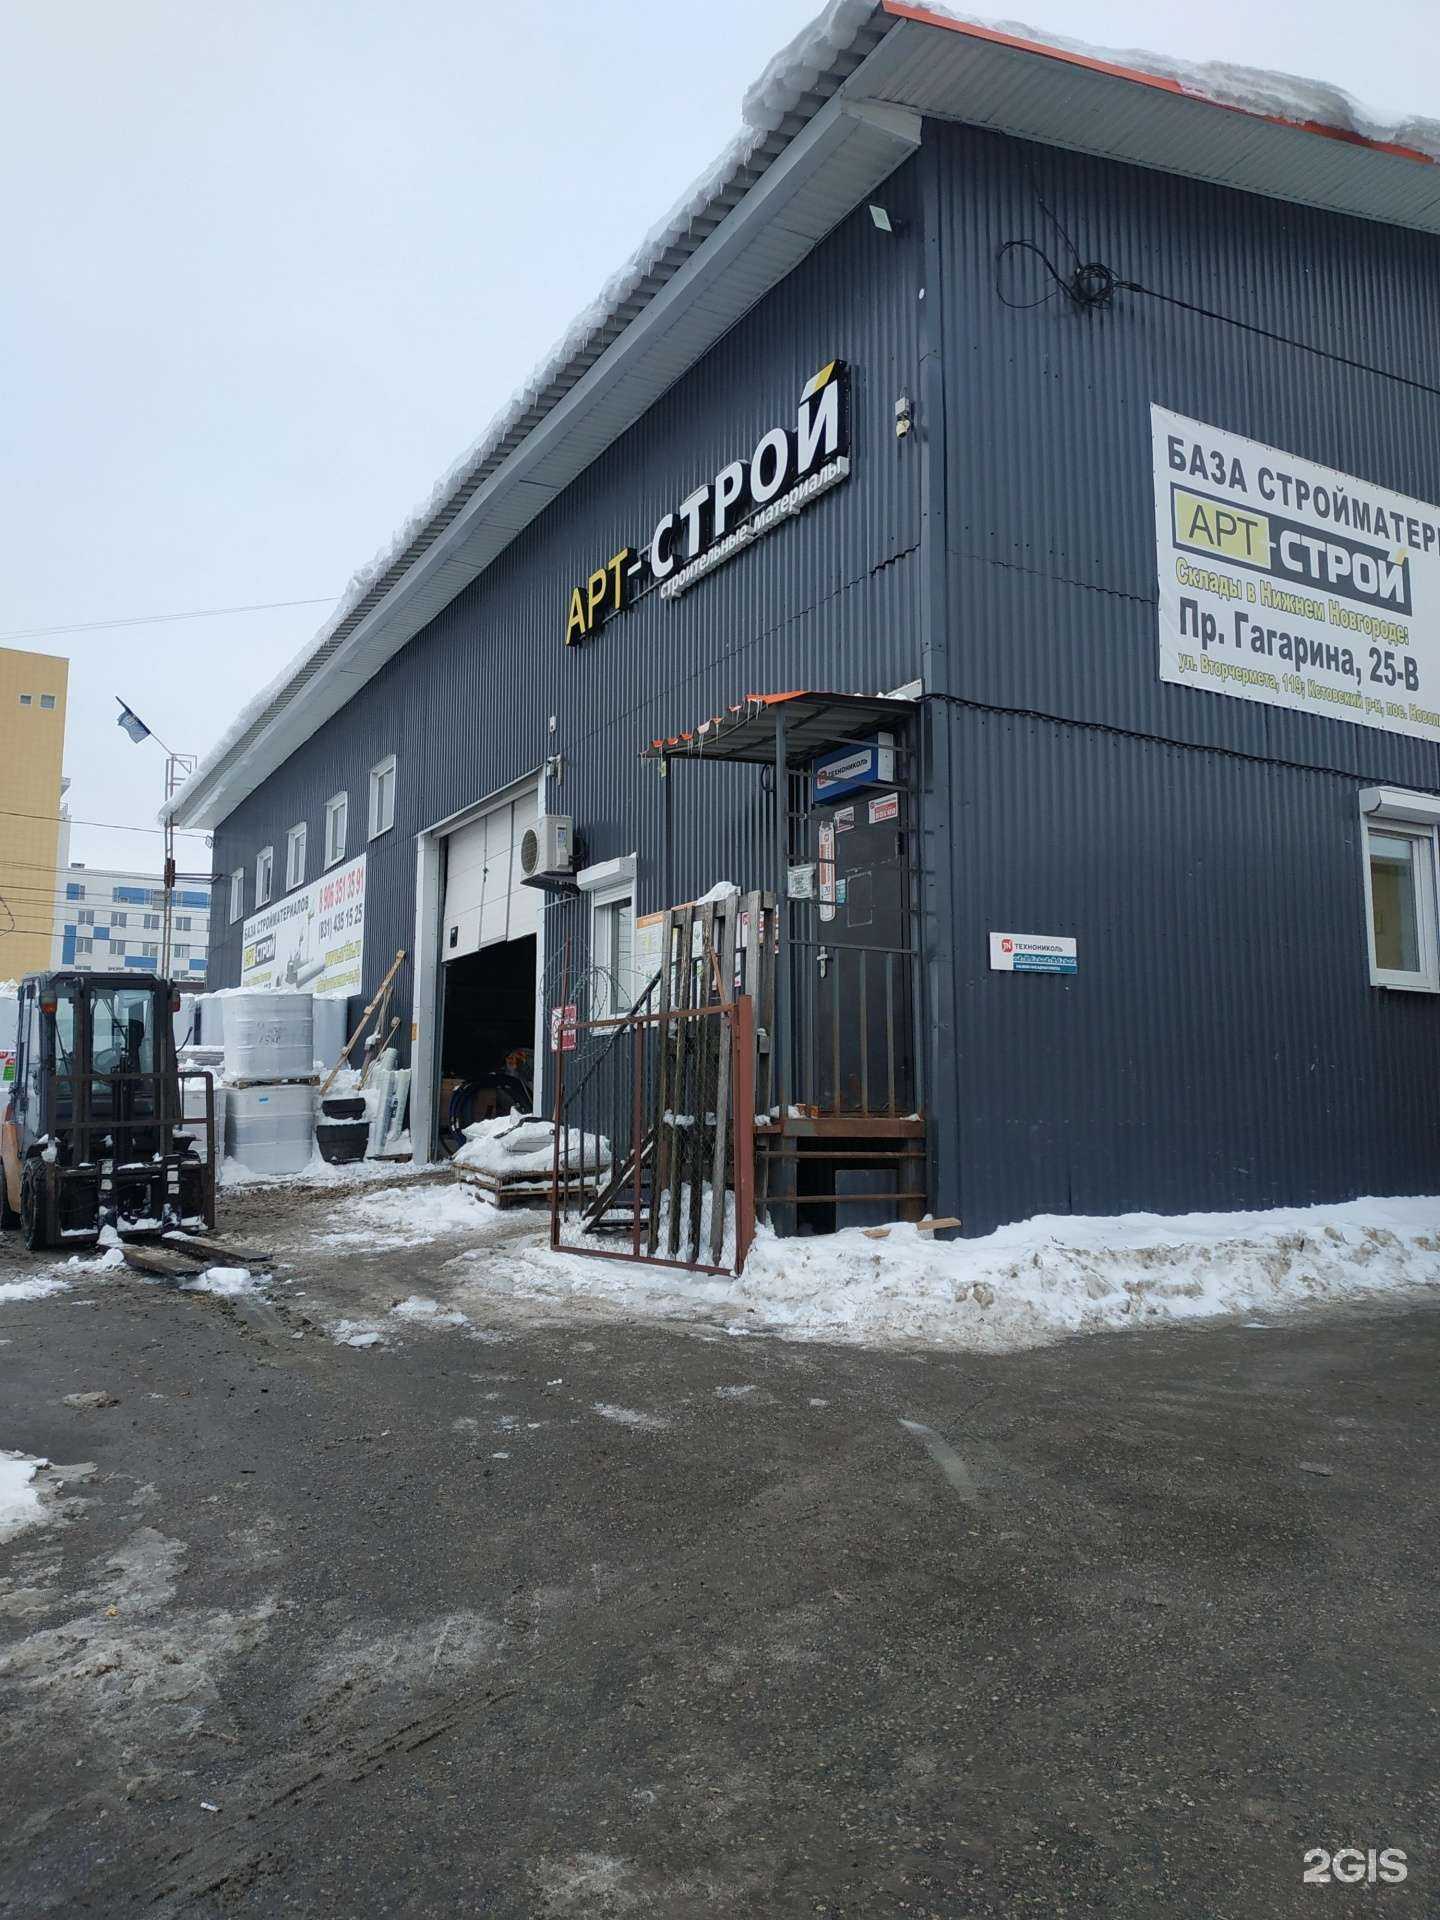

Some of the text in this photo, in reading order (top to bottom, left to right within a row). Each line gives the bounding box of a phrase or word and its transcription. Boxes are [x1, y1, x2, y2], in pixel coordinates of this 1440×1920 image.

[566, 359, 840, 646] АРТ-СТРОЙ
[660, 455, 846, 600] строительные материалы
[1167, 434, 1440, 560] БАЗА СТРОЙМАТЕР
[1175, 557, 1409, 646] Склады в Нижнем Новгороде:
[1188, 504, 1406, 604] АРТ-СТРОЙ
[1178, 652, 1198, 673] ул.
[1201, 654, 1279, 695] Вторчермета,
[1307, 679, 1364, 710] Кстовский
[1179, 596, 1420, 692] Пр. Гагарина, 25-В
[354, 903, 363, 924] 25
